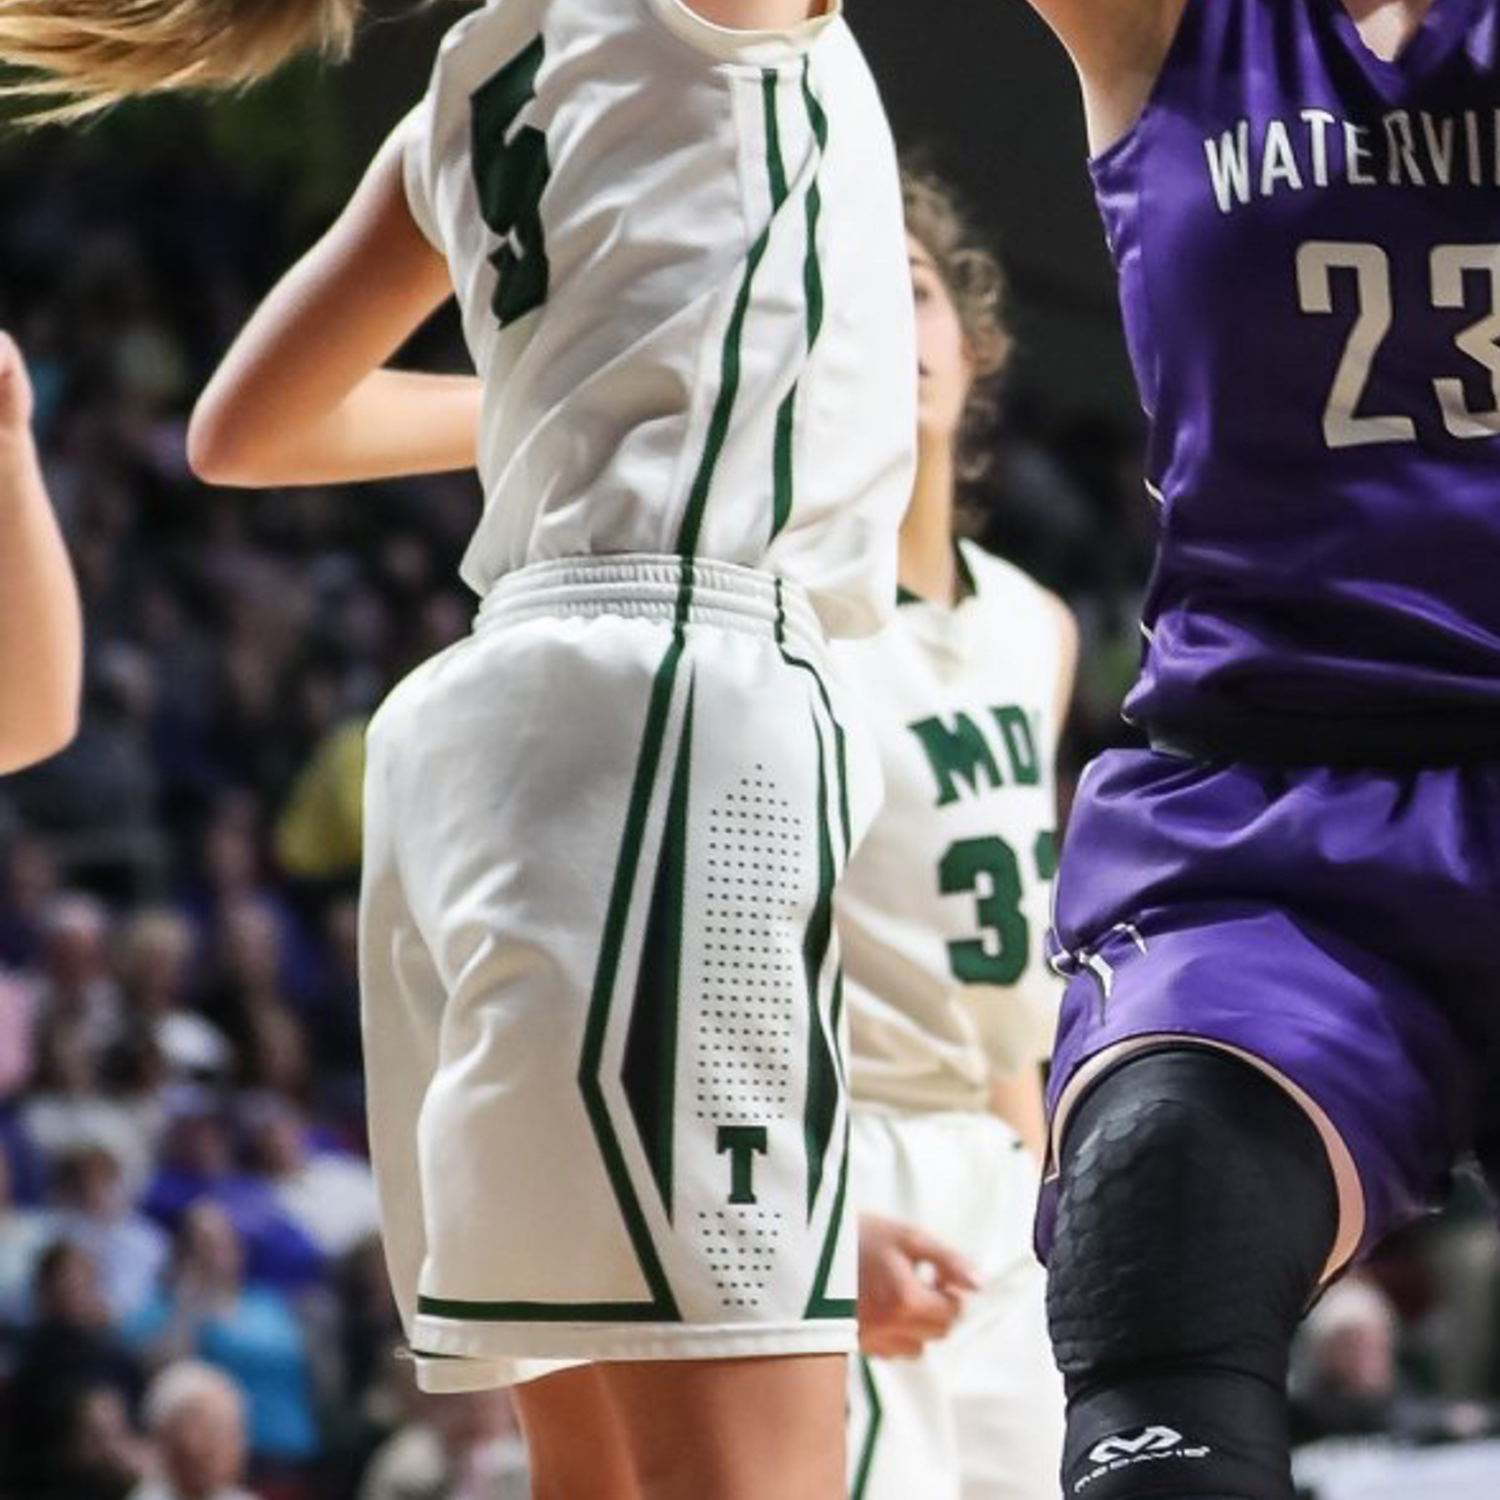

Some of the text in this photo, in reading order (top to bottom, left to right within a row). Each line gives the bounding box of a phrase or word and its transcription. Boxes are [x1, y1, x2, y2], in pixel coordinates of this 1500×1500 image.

[469, 32, 551, 331] 5
[936, 830, 1062, 988] 3
[715, 1125, 768, 1205] T
